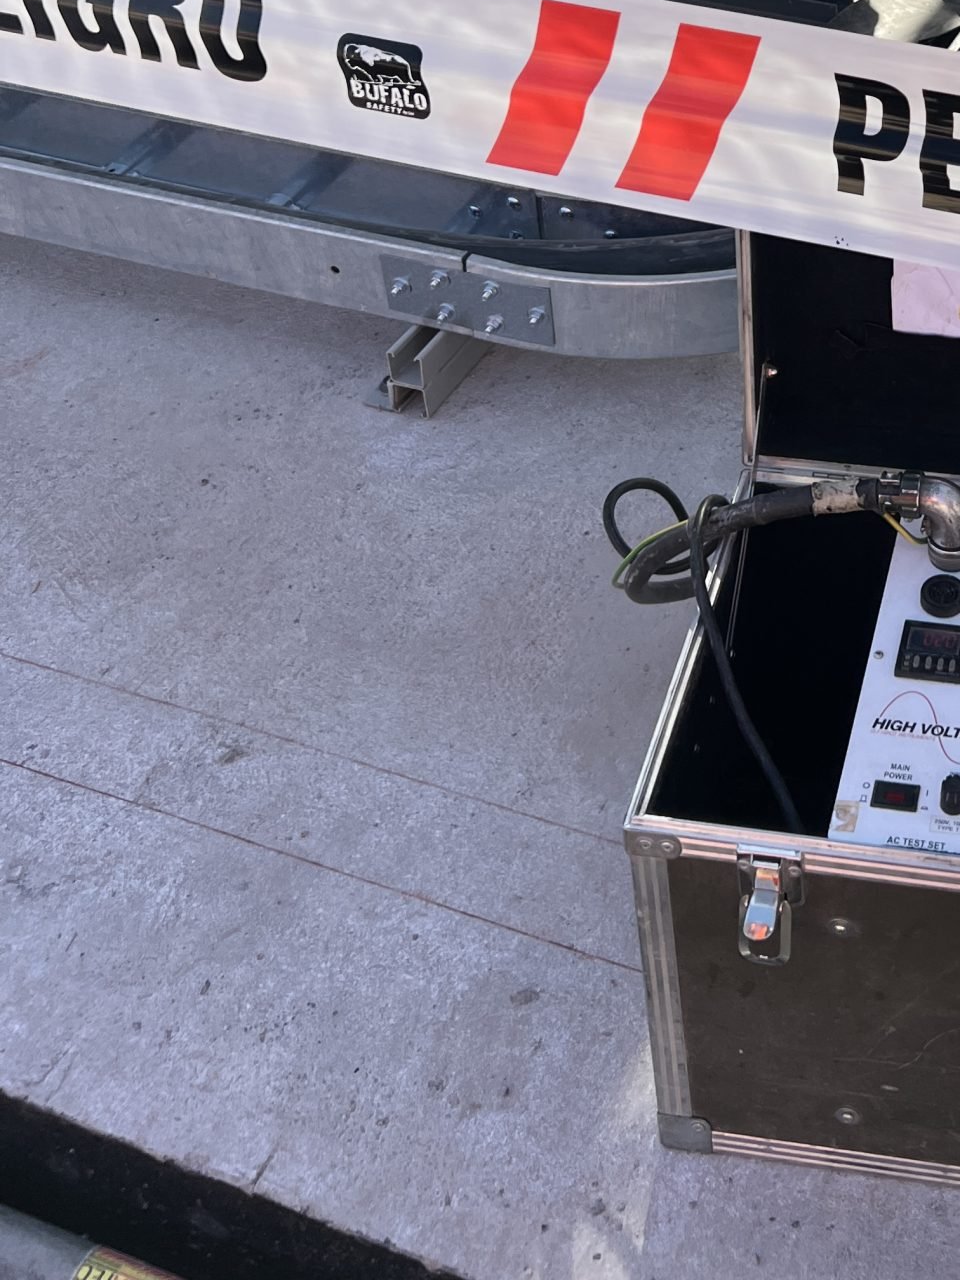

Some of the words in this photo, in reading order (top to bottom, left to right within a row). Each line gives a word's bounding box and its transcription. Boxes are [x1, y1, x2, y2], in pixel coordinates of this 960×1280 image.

[350, 75, 428, 111] BUFALO
[366, 101, 403, 114] SAFETY
[872, 718, 916, 734] HIGH
[890, 763, 911, 771] MAIN
[884, 772, 913, 781] POWER
[886, 836, 900, 845] AC
[903, 837, 926, 848] TEST
[928, 840, 946, 850] SET
